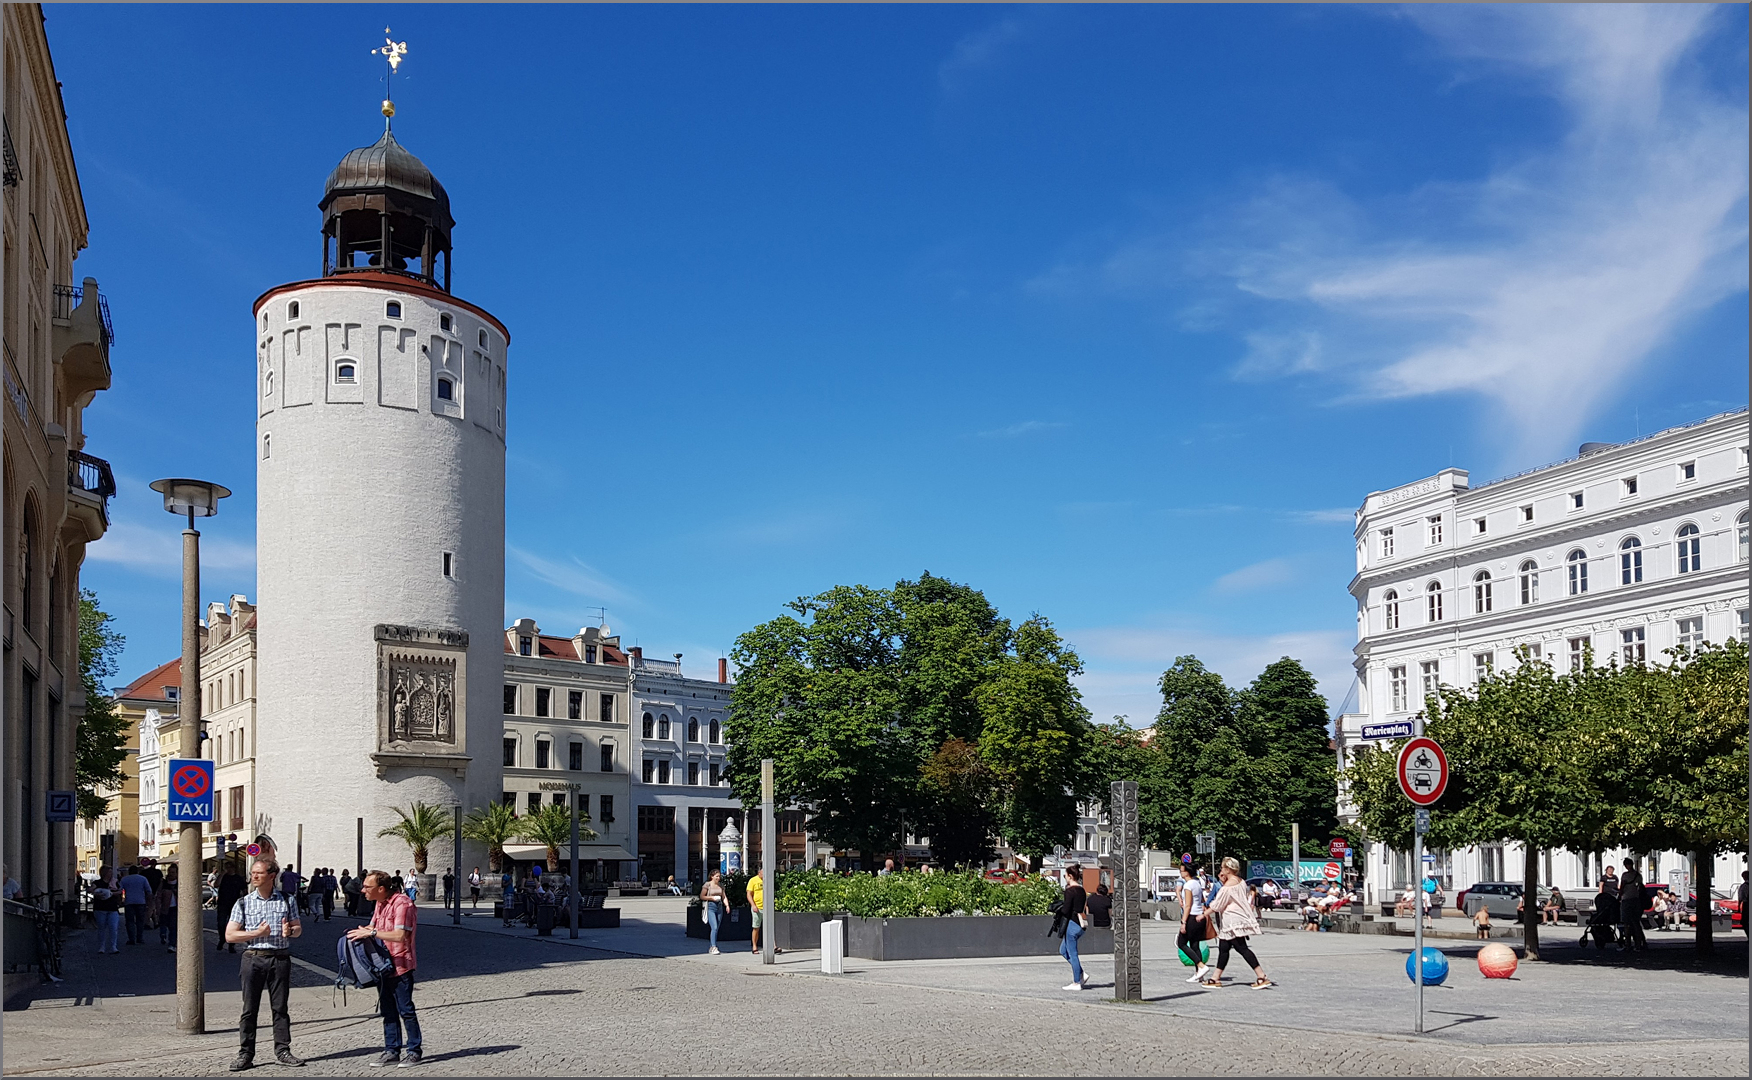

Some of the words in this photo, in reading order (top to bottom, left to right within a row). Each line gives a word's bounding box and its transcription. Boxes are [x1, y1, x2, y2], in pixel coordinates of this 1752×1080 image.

[1364, 725, 1409, 736] Marienplatz
[539, 782, 581, 791] MODEHAUS
[172, 803, 209, 816] TAXI
[1266, 863, 1324, 877] CORONA
[1114, 858, 1124, 953] MARIENPLATZ
[1127, 878, 1140, 993] NEUGESTALTUNG
